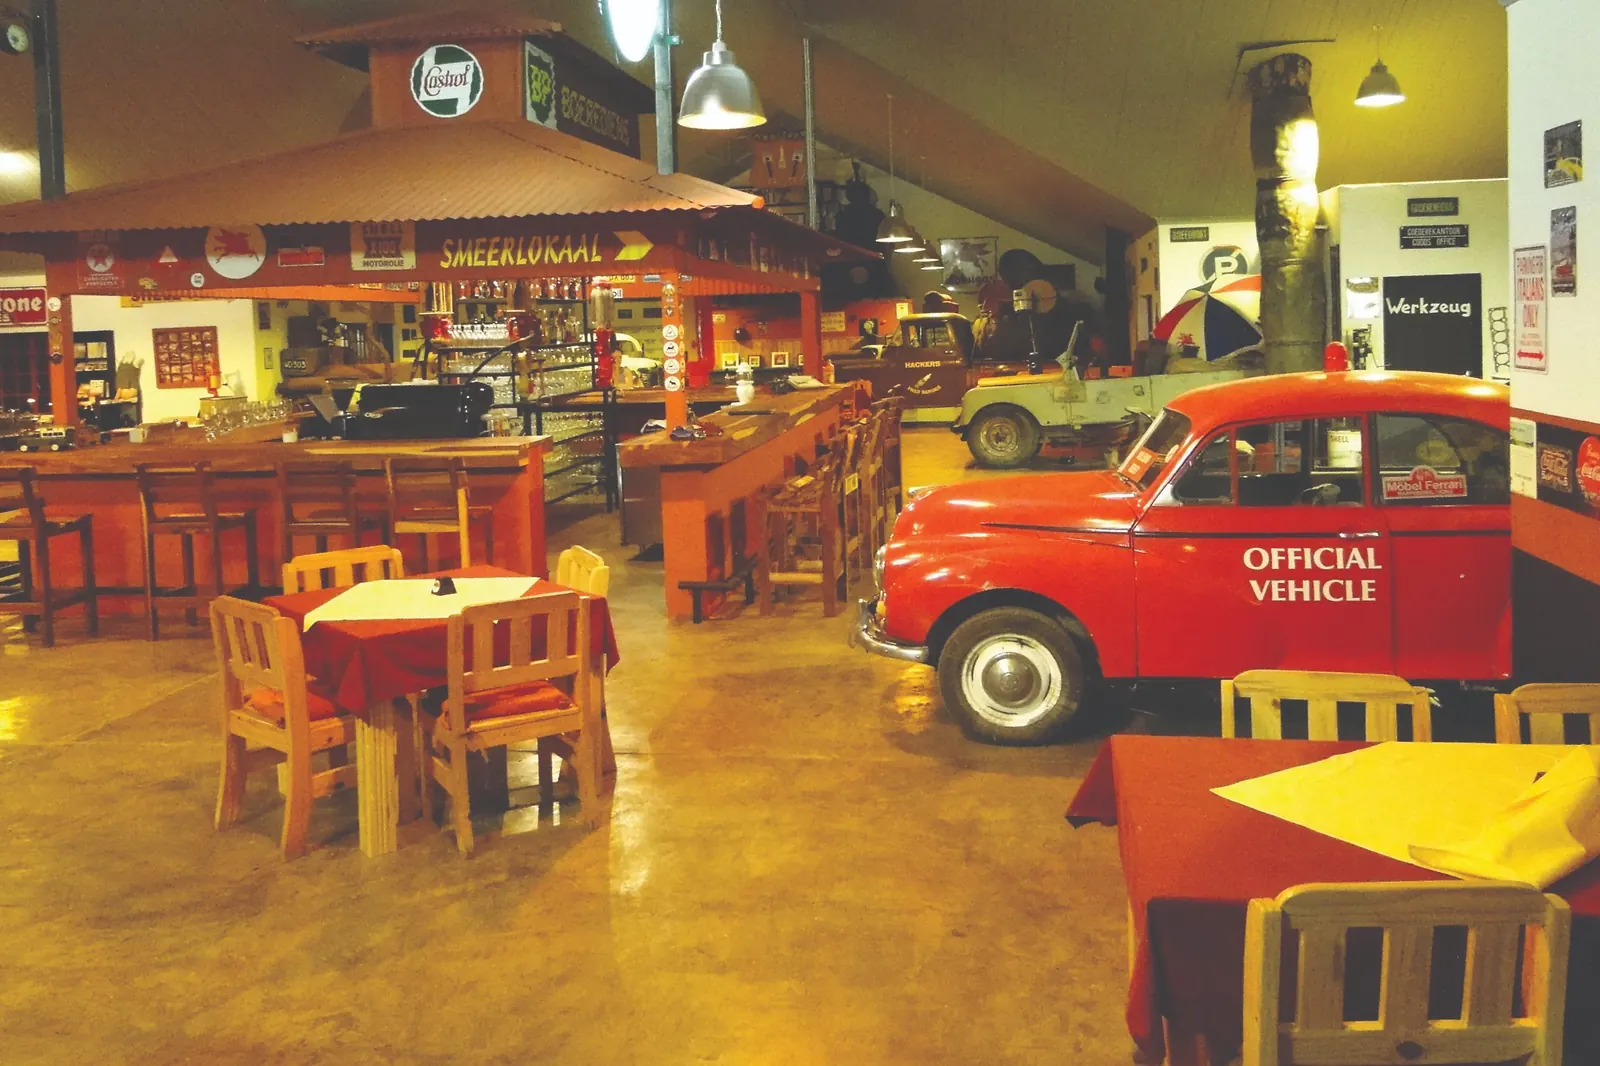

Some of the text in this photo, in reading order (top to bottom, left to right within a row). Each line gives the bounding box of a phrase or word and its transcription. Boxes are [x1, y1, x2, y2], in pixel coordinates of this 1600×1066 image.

[424, 64, 471, 97] Castrol
[529, 64, 551, 107] BP
[439, 233, 603, 269] SMEERLOKAAL
[1386, 297, 1472, 317] Werkzeug
[1387, 479, 1463, 492] Möbel Ferrari
[1243, 547, 1382, 570] OFFICIAL
[1249, 579, 1376, 602] VEHICLE
